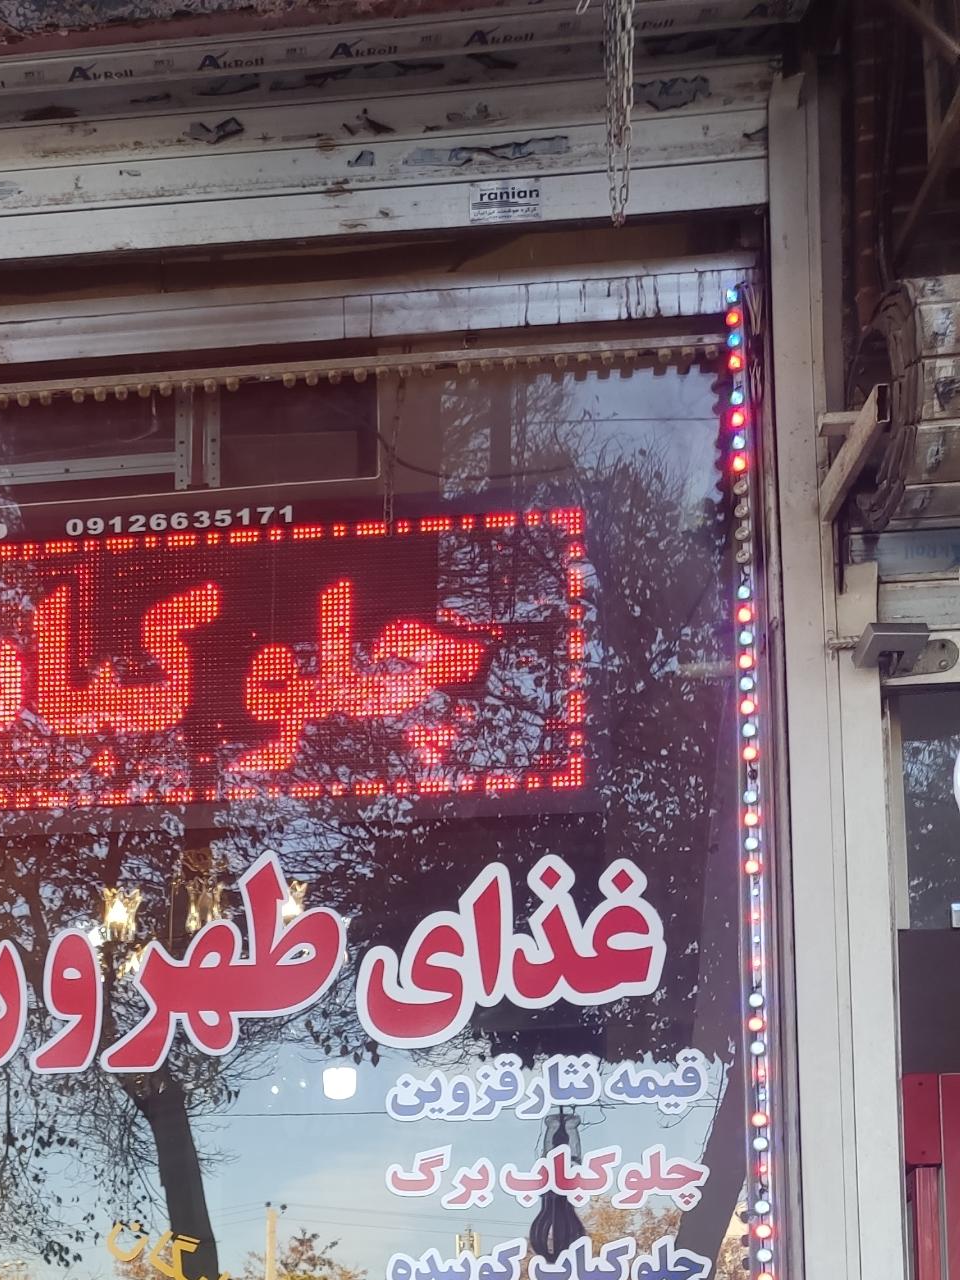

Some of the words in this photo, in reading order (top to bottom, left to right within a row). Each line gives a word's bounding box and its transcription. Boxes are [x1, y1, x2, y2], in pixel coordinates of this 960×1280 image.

[480, 186, 539, 201] ranian
[65, 505, 294, 536] 09126635171
[230, 580, 483, 775] چلو
[358, 854, 666, 1047] غذای
[605, 1048, 707, 1114] قیمه
[385, 1144, 494, 1210] برگ
